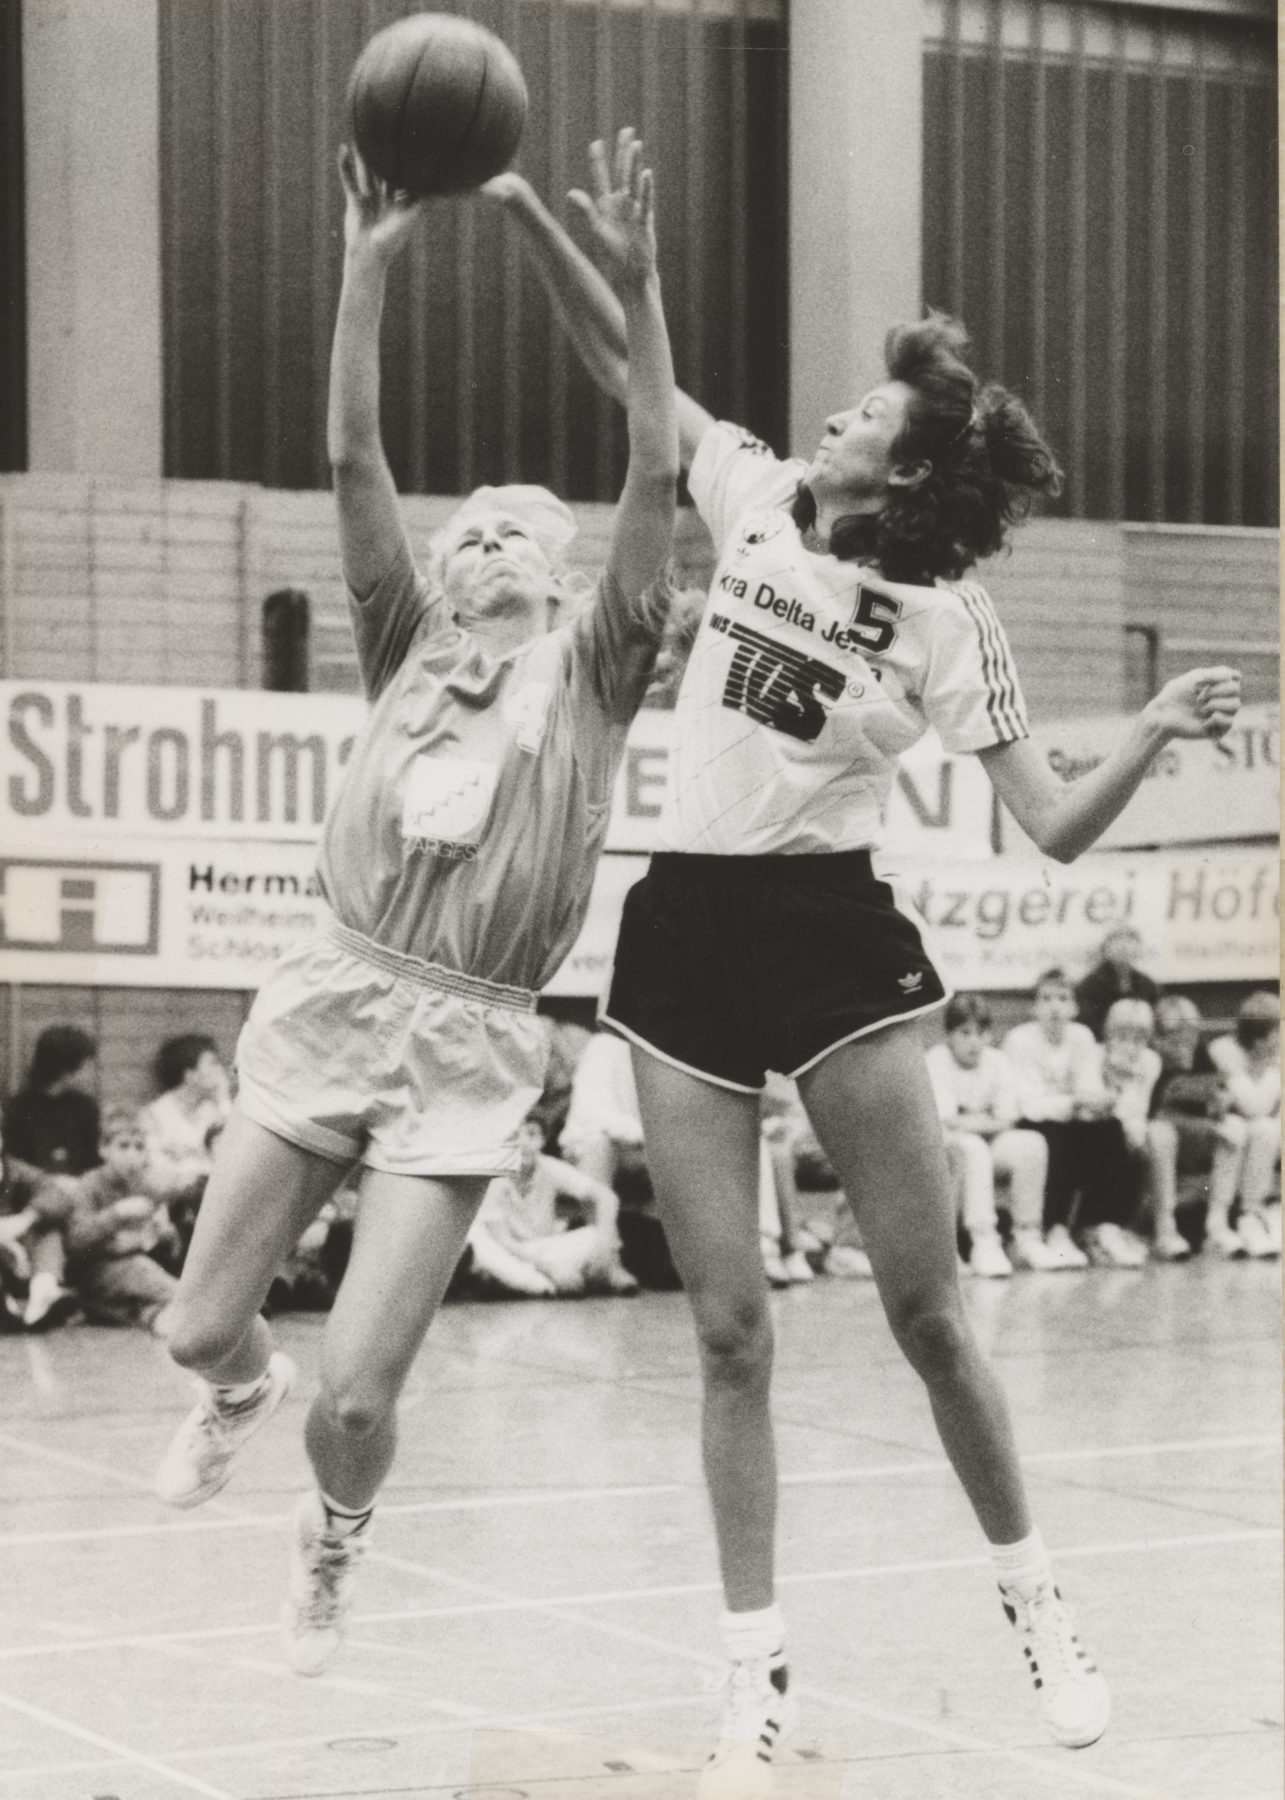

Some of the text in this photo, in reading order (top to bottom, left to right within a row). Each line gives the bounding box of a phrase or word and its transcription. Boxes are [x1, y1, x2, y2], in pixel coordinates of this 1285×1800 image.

[754, 582, 817, 633] Delta
[851, 583, 903, 655] 5
[8, 691, 356, 824] Strohm
